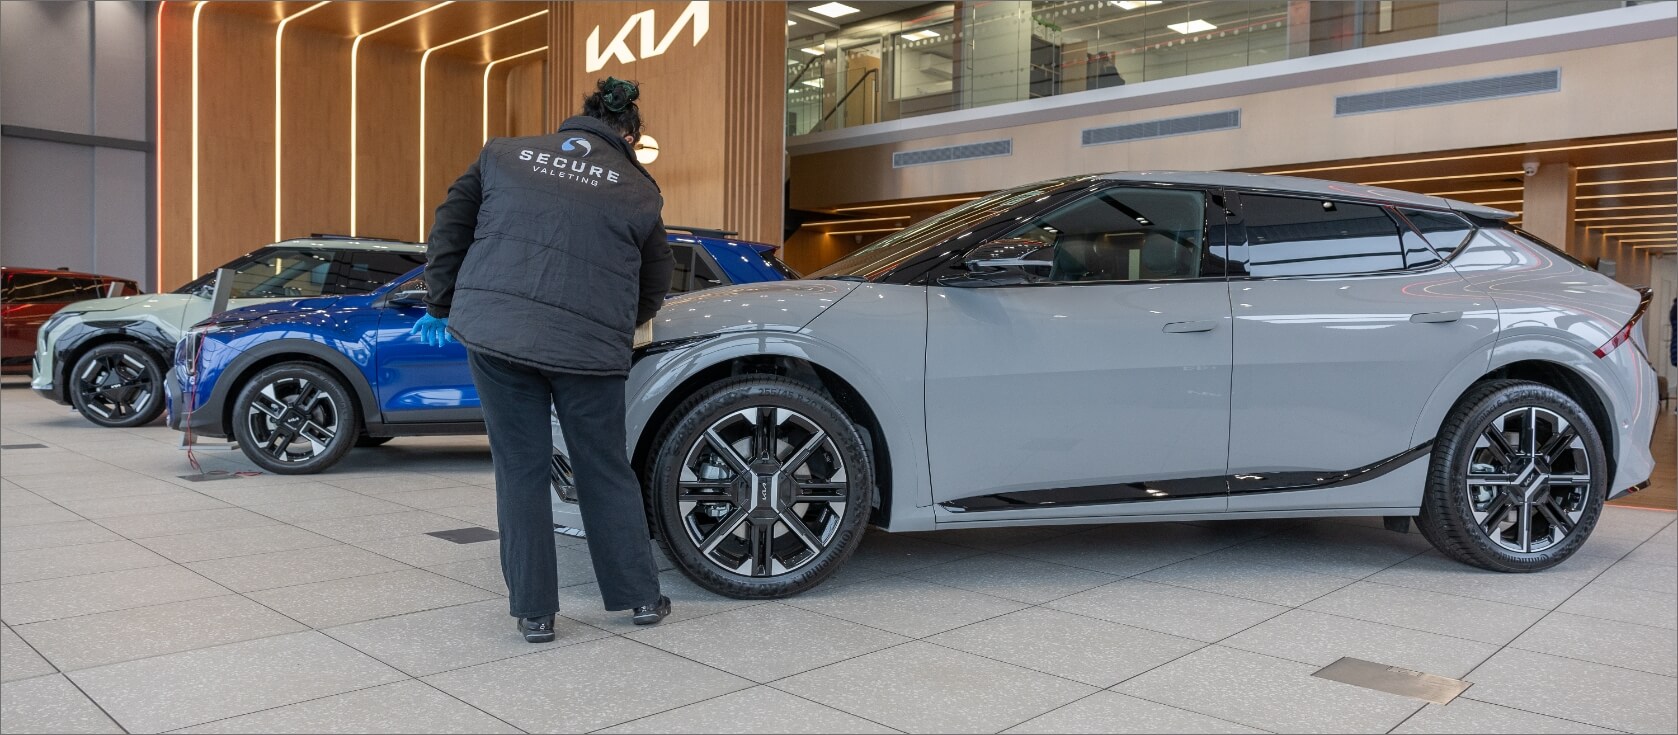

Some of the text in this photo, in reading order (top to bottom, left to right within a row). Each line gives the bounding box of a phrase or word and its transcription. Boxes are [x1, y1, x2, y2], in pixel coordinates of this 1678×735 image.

[519, 149, 620, 183] SECURE
[533, 165, 598, 187] VALETING
[802, 529, 854, 582] Continental
